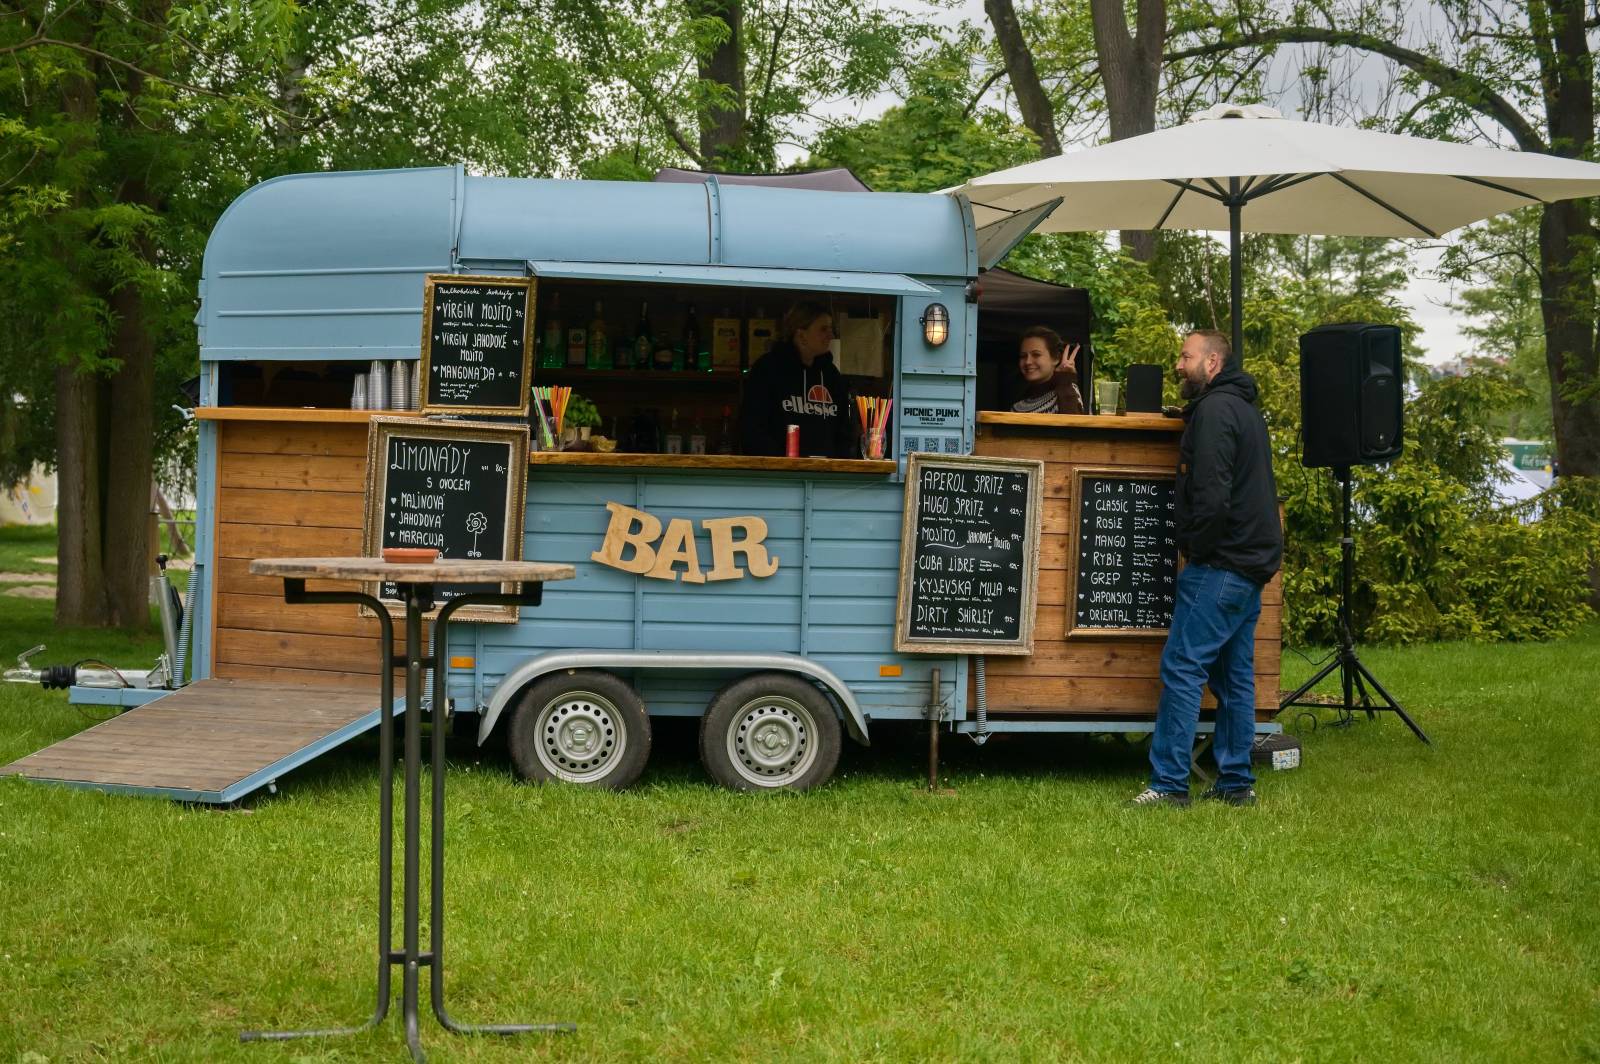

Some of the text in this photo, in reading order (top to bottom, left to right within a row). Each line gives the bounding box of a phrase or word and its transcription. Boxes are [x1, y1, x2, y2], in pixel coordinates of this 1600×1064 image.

[782, 395, 838, 417] ellesse
[903, 407, 960, 418] PICNIC PUNX
[426, 476, 471, 492] S OVOCEM
[924, 470, 968, 494] APEROL
[1117, 484, 1124, 493] &
[923, 494, 949, 514] HUGO
[398, 512, 445, 529] JAHODOVÁ
[399, 530, 444, 547] MARACUJA
[591, 500, 780, 585] BAR
[1094, 534, 1126, 548] MANGO
[919, 554, 942, 571] CUBA
[1093, 551, 1123, 567] RYBÍZ
[919, 577, 976, 596] KYJEVSKÁ
[1090, 572, 1121, 585] GREP
[1089, 590, 1133, 605] JAPONSKO
